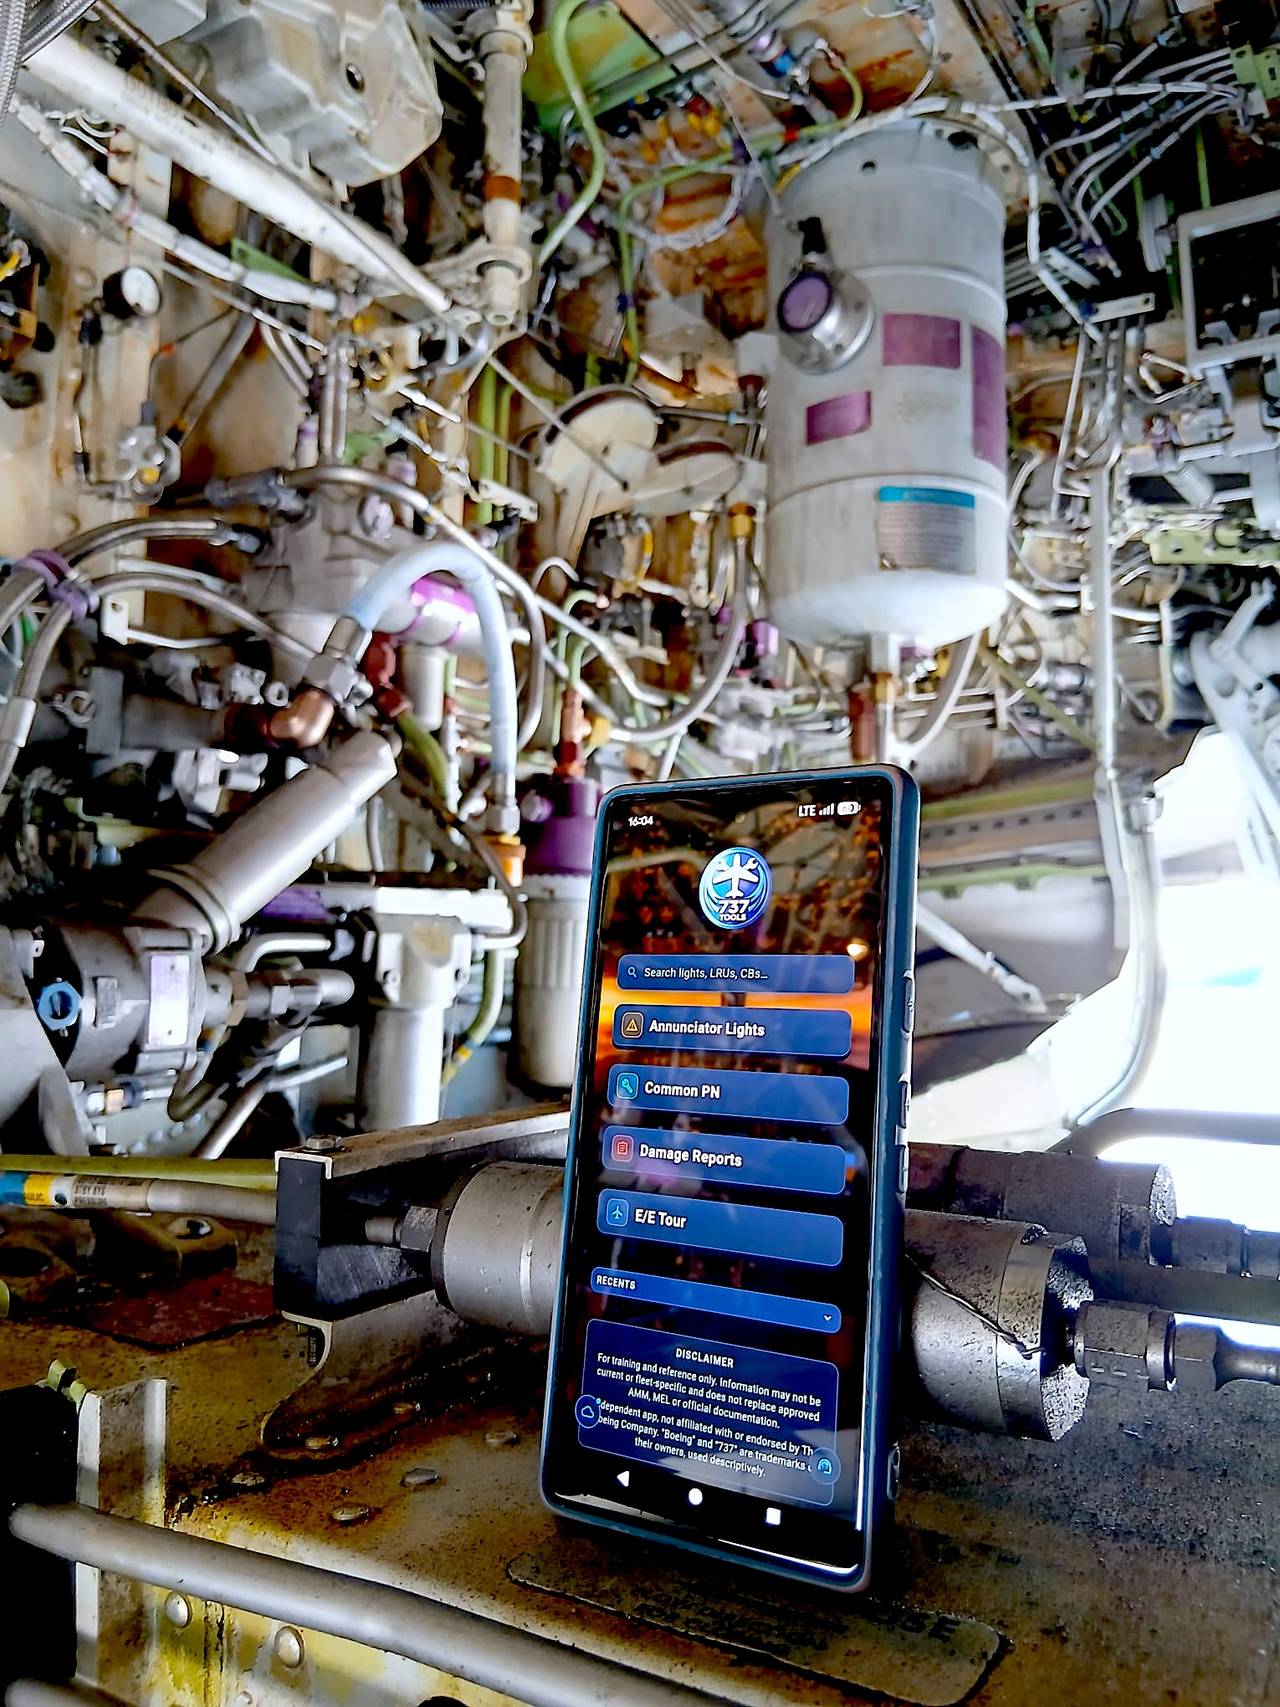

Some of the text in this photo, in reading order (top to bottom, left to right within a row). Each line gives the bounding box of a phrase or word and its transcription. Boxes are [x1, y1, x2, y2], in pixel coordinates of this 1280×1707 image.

[798, 804, 817, 817] LTE
[718, 899, 750, 914] 737
[719, 913, 747, 922] TOOLS
[644, 967, 676, 978] Search
[678, 967, 708, 980] lights,
[709, 968, 738, 979] LRUs,
[649, 1019, 766, 1038] Annunciator Lights
[644, 1081, 721, 1099] Common PN
[639, 1144, 743, 1168] Damage Reports
[634, 1208, 687, 1229] E/E Tour
[596, 1275, 636, 1290] RECENTS
[675, 1347, 734, 1369] DISCLAIMER
[597, 1352, 821, 1407] For training and reference only. Information may not be
[596, 1368, 820, 1422] current or fleet-specific and does not replace approved
[627, 1387, 780, 1429] AMM, MEL or official documentation.
[600, 1400, 813, 1456] dependent app, not affiliated with or endorsed by Th
[620, 1419, 659, 1438] Company.
[661, 1428, 696, 1446] "Boeing"
[696, 1438, 713, 1449] and
[715, 1440, 738, 1453] "737"
[739, 1448, 753, 1458] are
[755, 1451, 806, 1470] trademarks
[634, 1436, 766, 1477] their owners, used descriptively.
